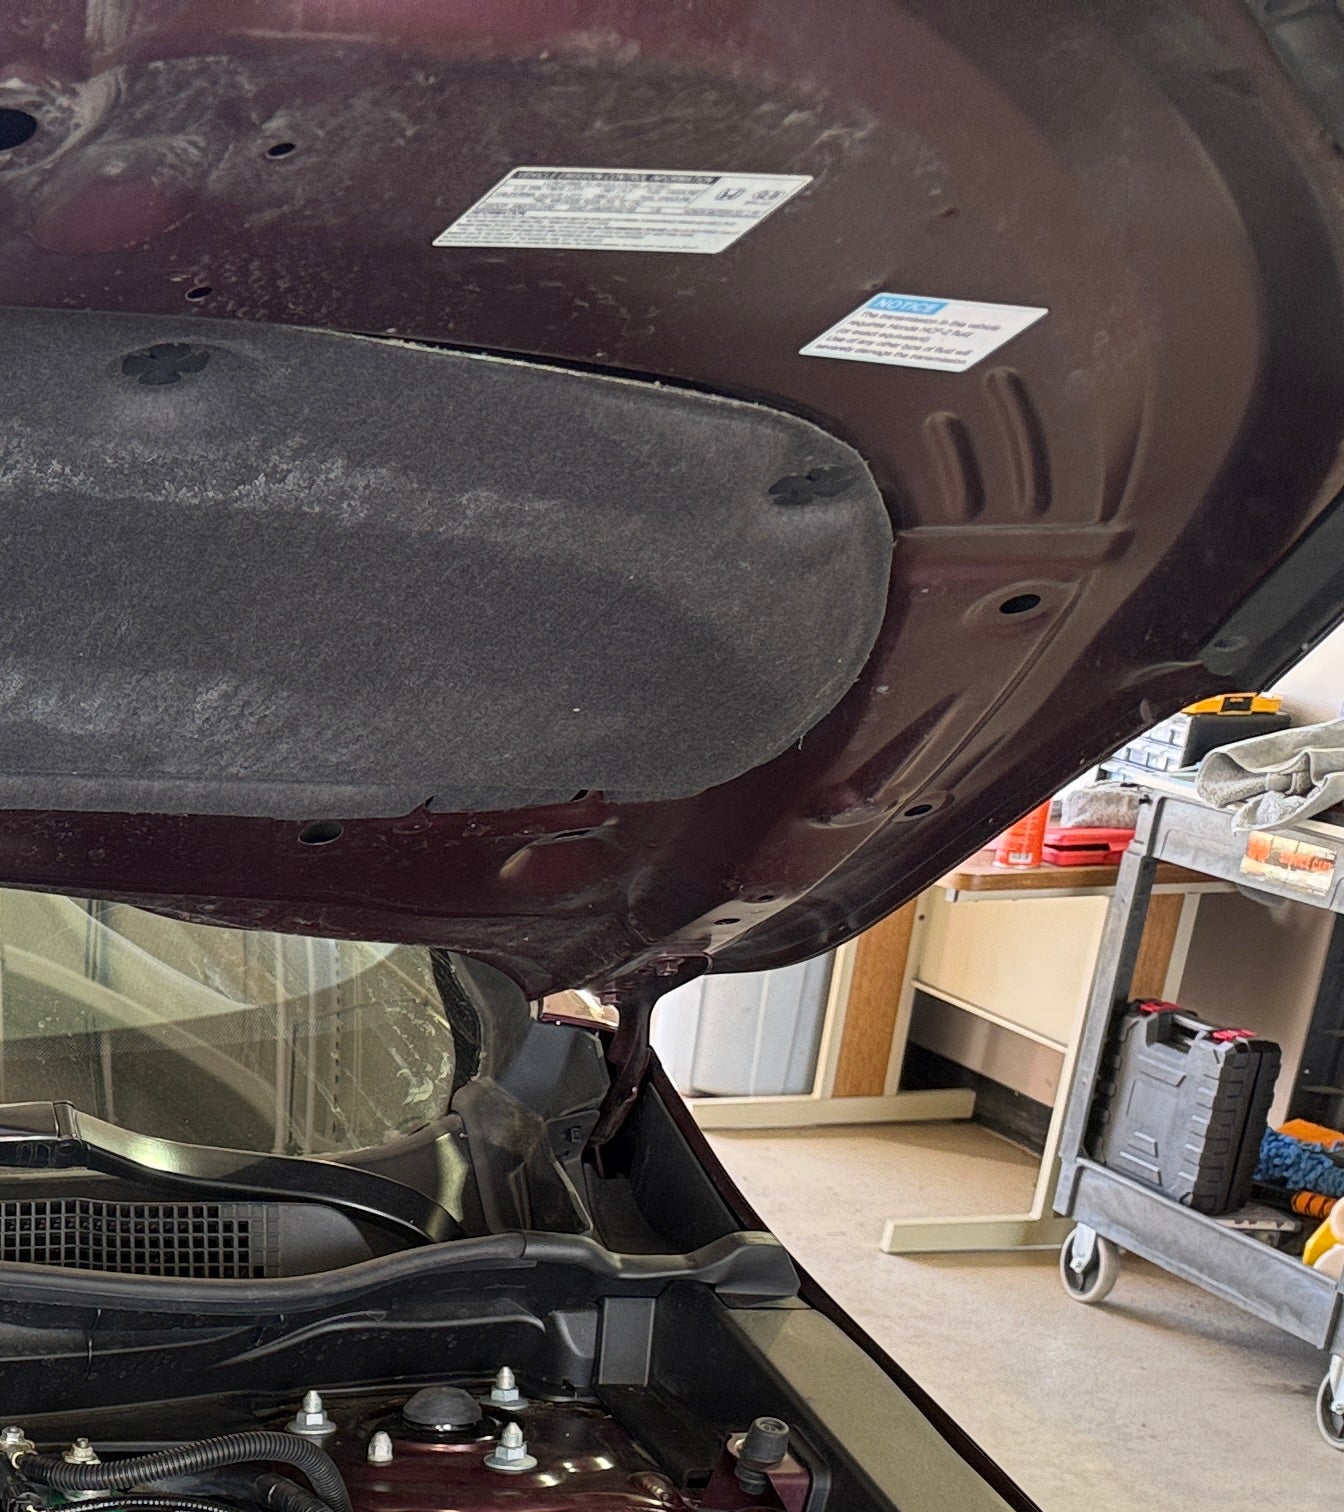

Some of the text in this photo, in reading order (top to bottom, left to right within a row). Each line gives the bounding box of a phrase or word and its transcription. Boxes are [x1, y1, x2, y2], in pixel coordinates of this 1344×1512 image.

[875, 297, 938, 312] NOTICE
[888, 323, 919, 332] Honda
[854, 348, 892, 357] damage
